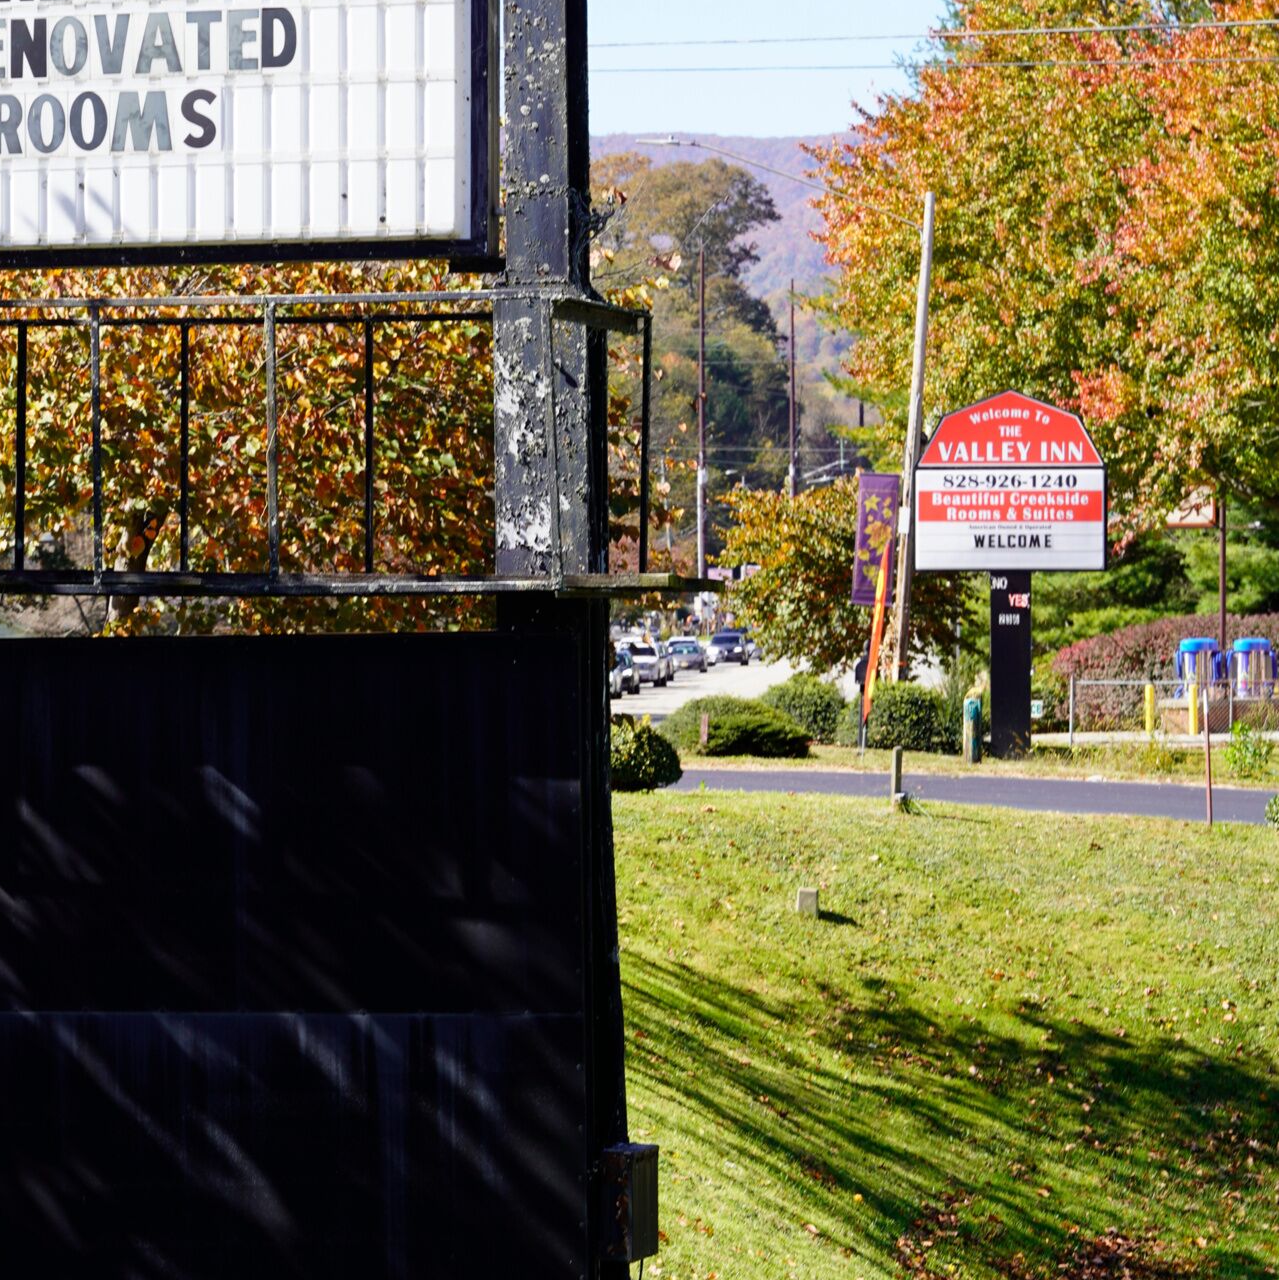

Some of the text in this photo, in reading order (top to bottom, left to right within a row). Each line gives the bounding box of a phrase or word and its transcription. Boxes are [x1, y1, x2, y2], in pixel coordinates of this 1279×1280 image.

[969, 408, 1050, 425] Welcome To
[999, 425, 1022, 437] THE
[938, 441, 1083, 462] VALLEY INN
[943, 474, 1077, 488] 828-926-1240
[932, 492, 1089, 505] Beautiful Creekside
[946, 507, 1074, 520] Rooms & Suites
[974, 534, 1052, 548] WELCOME
